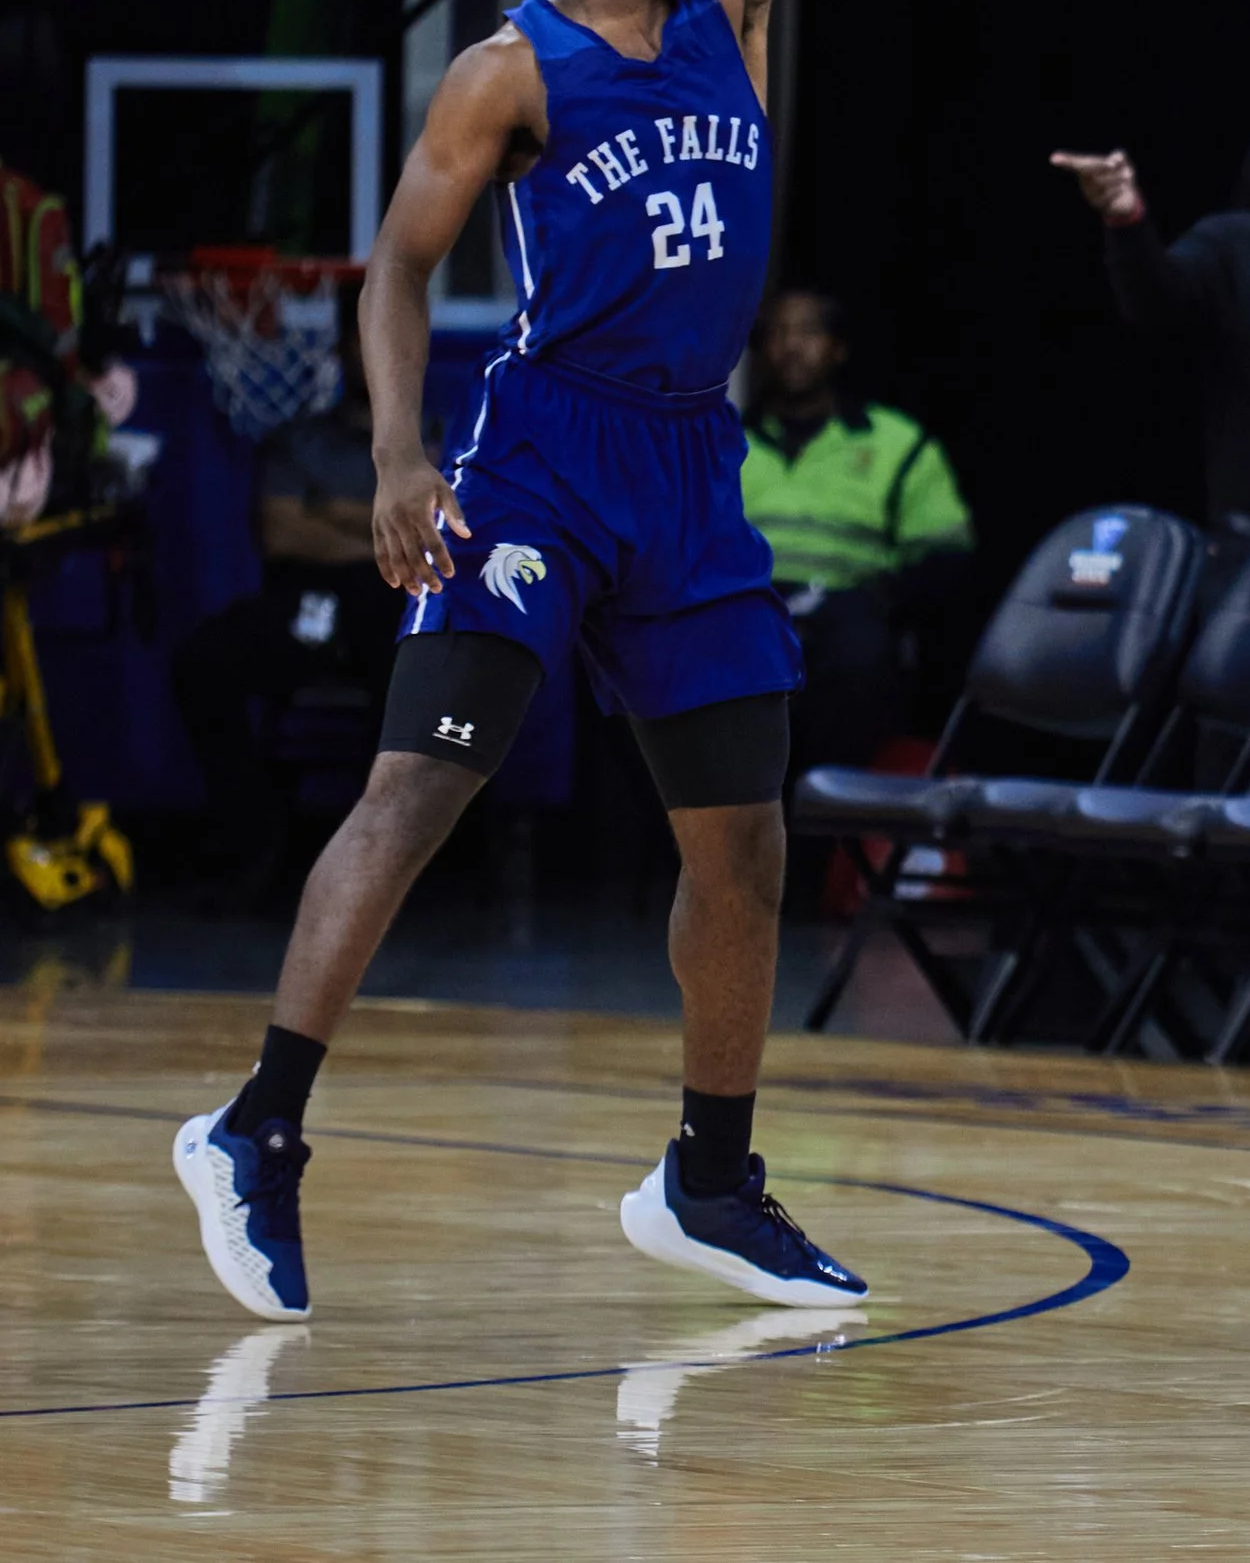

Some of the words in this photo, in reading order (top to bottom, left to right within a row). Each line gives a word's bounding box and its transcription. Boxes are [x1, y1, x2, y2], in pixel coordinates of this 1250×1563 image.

[565, 129, 649, 205] THE
[654, 114, 760, 171] FALLS
[645, 181, 726, 270] 24
